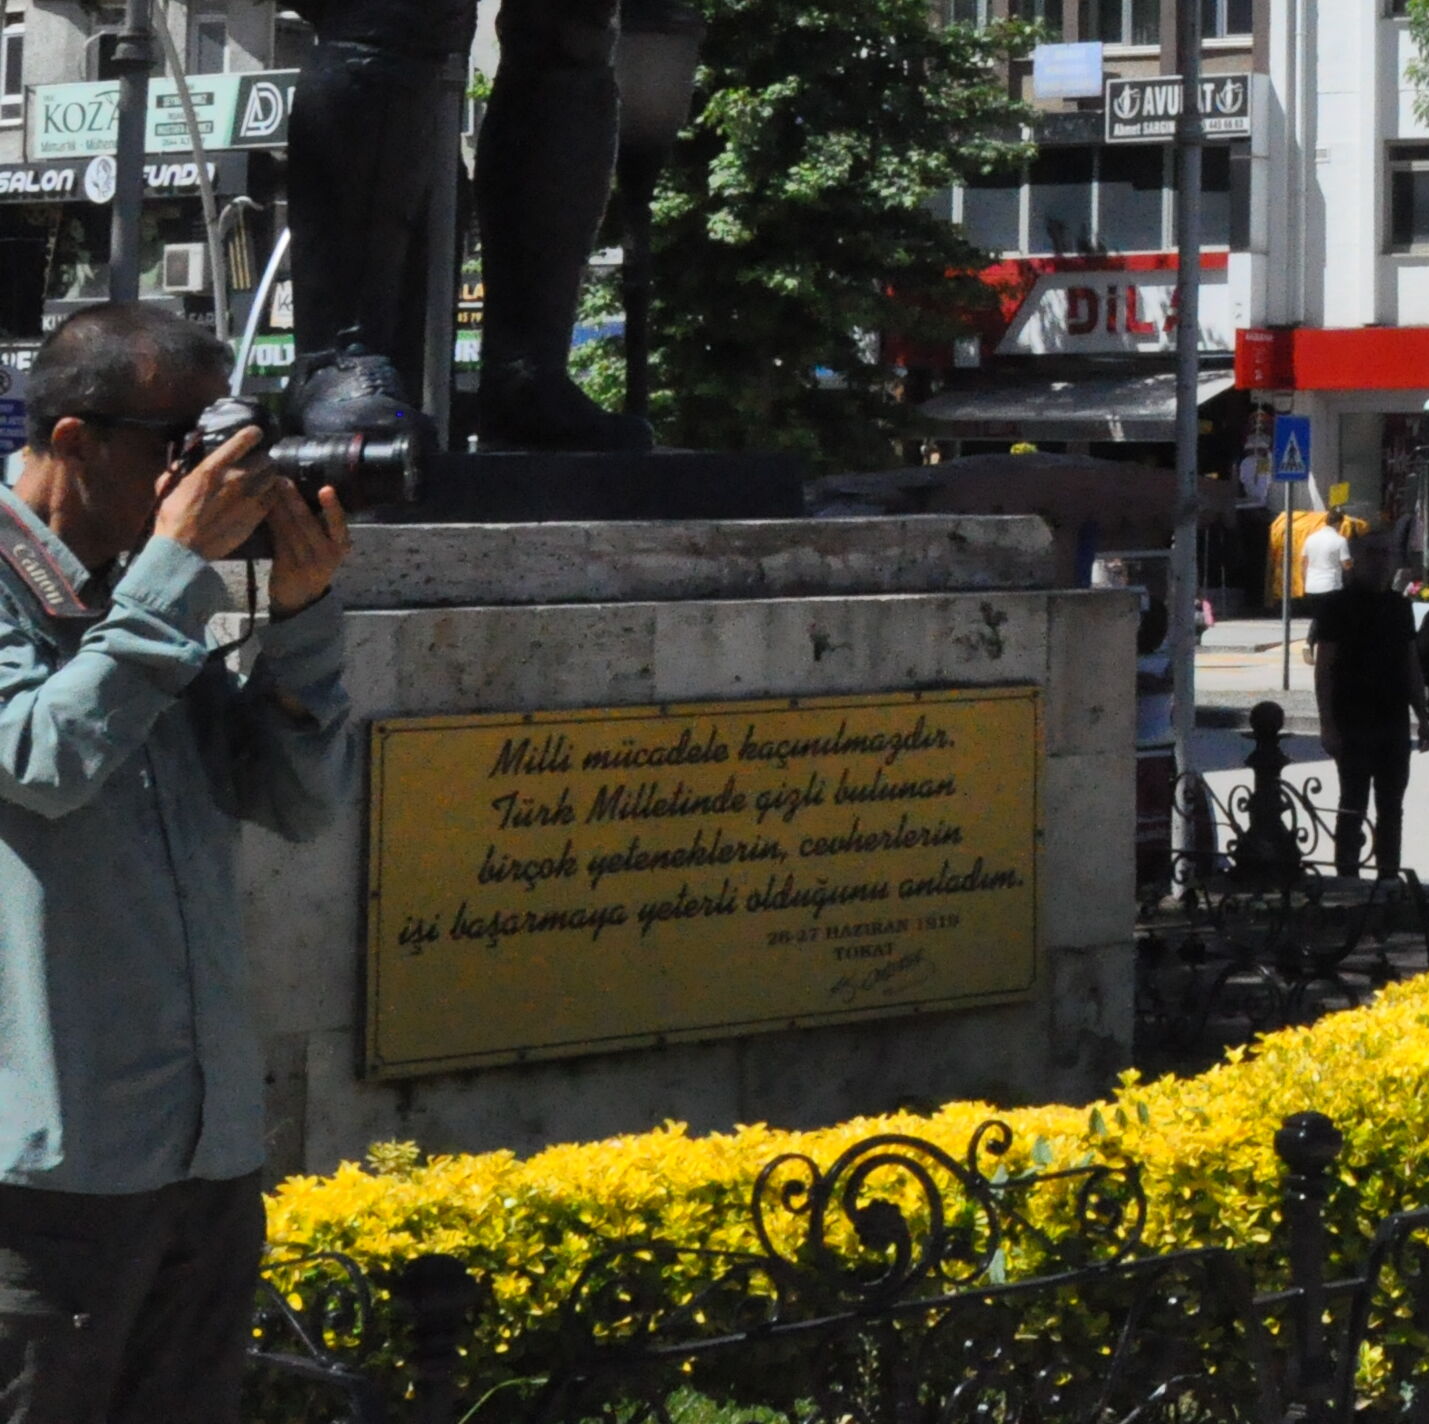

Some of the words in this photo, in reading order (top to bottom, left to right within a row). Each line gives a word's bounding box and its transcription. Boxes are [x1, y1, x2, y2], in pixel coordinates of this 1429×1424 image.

[1143, 83, 1215, 117] AVUT
[13, 543, 64, 604] Canon
[488, 734, 574, 778] Milli
[582, 726, 729, 771] mücadele
[738, 715, 955, 770] kaçınılmazdır.
[491, 787, 576, 830] Türk
[585, 775, 747, 824] Milletinde
[756, 779, 826, 825] gizli
[834, 767, 957, 805] bulunan
[477, 838, 578, 893] birçok
[586, 826, 788, 891] yeteneklerin,
[800, 813, 963, 858] cevherlerin
[399, 913, 441, 956] işi
[449, 901, 629, 949] başarmaya
[638, 877, 738, 938] yeterli
[746, 873, 890, 920] olduğunu
[898, 856, 1024, 900] anladım.
[832, 942, 895, 962] TOKAT
